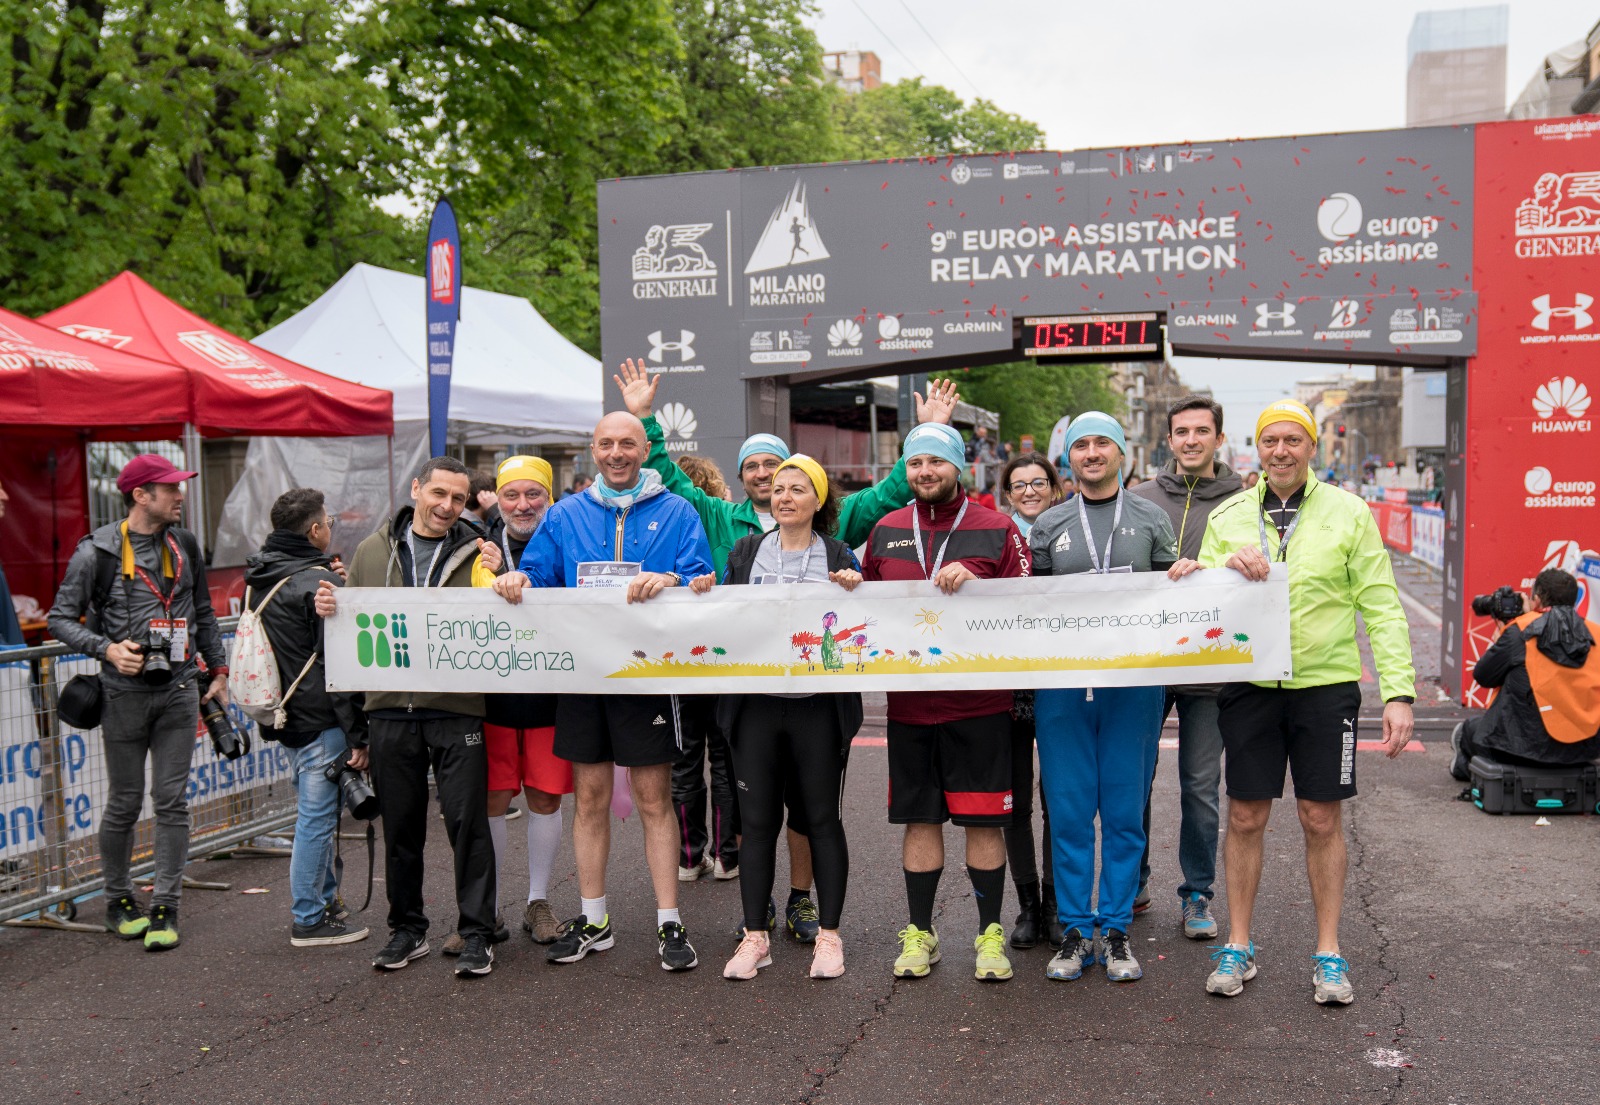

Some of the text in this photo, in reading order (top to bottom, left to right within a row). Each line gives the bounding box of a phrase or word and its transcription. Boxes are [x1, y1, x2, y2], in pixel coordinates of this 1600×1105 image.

[963, 226, 1056, 251] EUROP
[1063, 216, 1236, 247] ASSISTANCE
[1367, 215, 1438, 239] europ
[1318, 239, 1438, 264] assistance
[931, 243, 1237, 282] RELAY MARATHON
[632, 278, 717, 299] GENERALI
[749, 273, 826, 294] MILANO
[750, 291, 825, 306] MARATHON
[944, 321, 1005, 334] GARMIN
[1174, 313, 1239, 327] GARMIN
[901, 327, 933, 340] europ
[1034, 321, 1147, 348] 05:17:41
[1520, 335, 1556, 344] UNDER
[827, 347, 863, 357] HUAWEI
[879, 338, 933, 351] assistance
[645, 365, 668, 374] NDER
[1532, 420, 1591, 433] HUAWEI
[664, 441, 698, 452] AWEI
[1553, 480, 1596, 495] europ
[1525, 493, 1596, 508] assistance
[965, 607, 1222, 633] www.famiglieperaccoglienza.it
[426, 613, 538, 647] Famiglie per
[427, 643, 575, 677] l'Accoglienza
